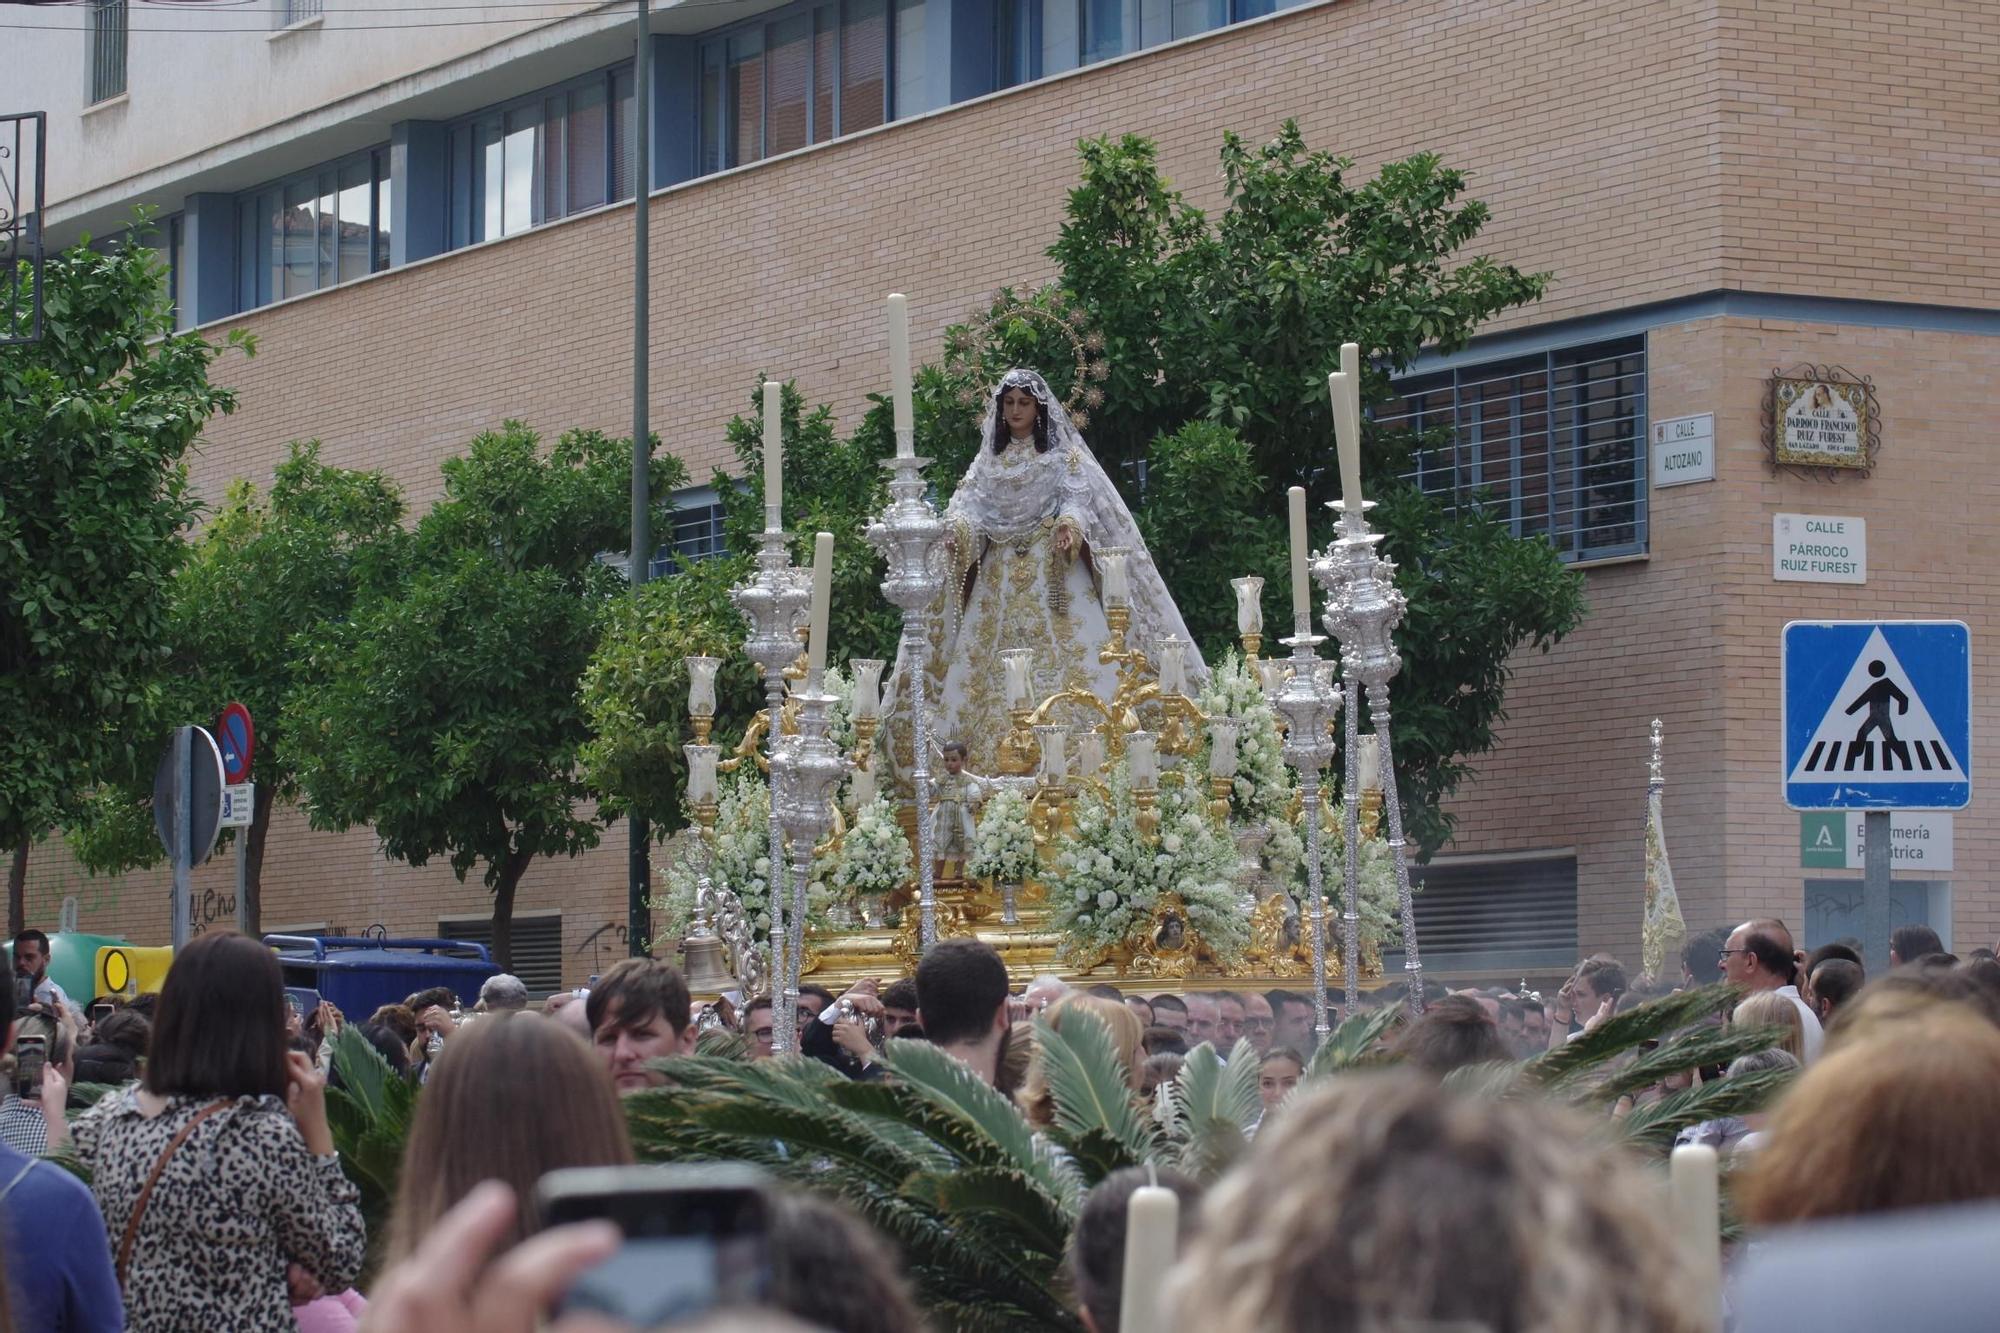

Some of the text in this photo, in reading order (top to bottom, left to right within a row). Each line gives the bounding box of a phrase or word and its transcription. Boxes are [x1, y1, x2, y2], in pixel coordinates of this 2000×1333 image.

[1811, 410, 1830, 418] CALLE
[1675, 421, 1695, 438] CALLE
[1797, 430, 1847, 444] RUIZ FUREST
[1664, 450, 1702, 471] ALTOZANO
[1806, 521, 1844, 534] CALLE
[1789, 542, 1849, 558] PÁRROCO
[1781, 559, 1858, 574] RUIZ FUREST
